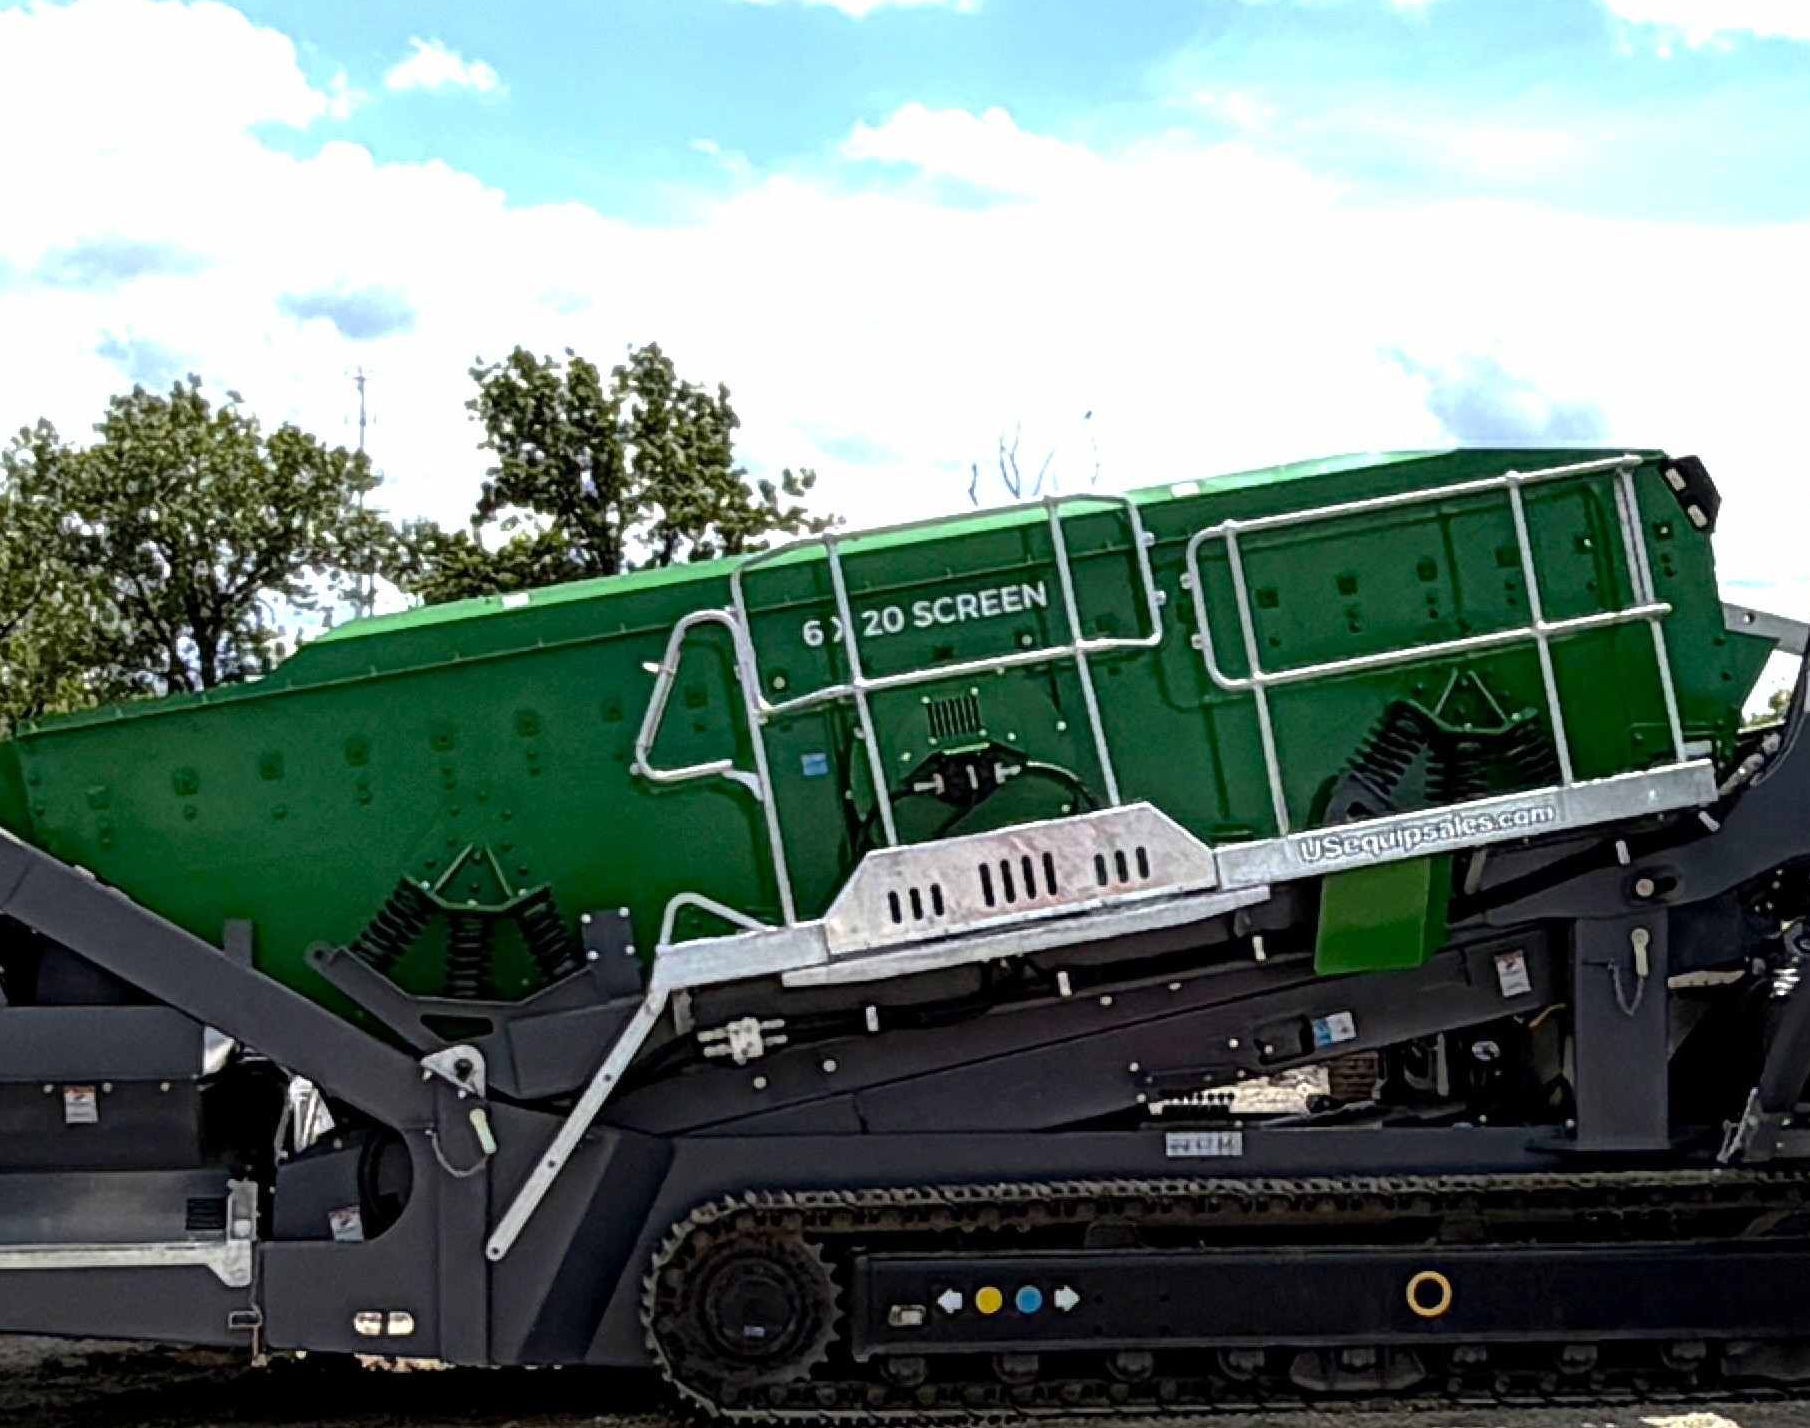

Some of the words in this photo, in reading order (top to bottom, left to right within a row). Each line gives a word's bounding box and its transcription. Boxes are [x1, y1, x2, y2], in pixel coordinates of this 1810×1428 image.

[802, 619, 825, 646] 6
[860, 605, 906, 637] 20
[911, 580, 1048, 628] SCREEN
[1298, 803, 1559, 863] USequipsales.com
